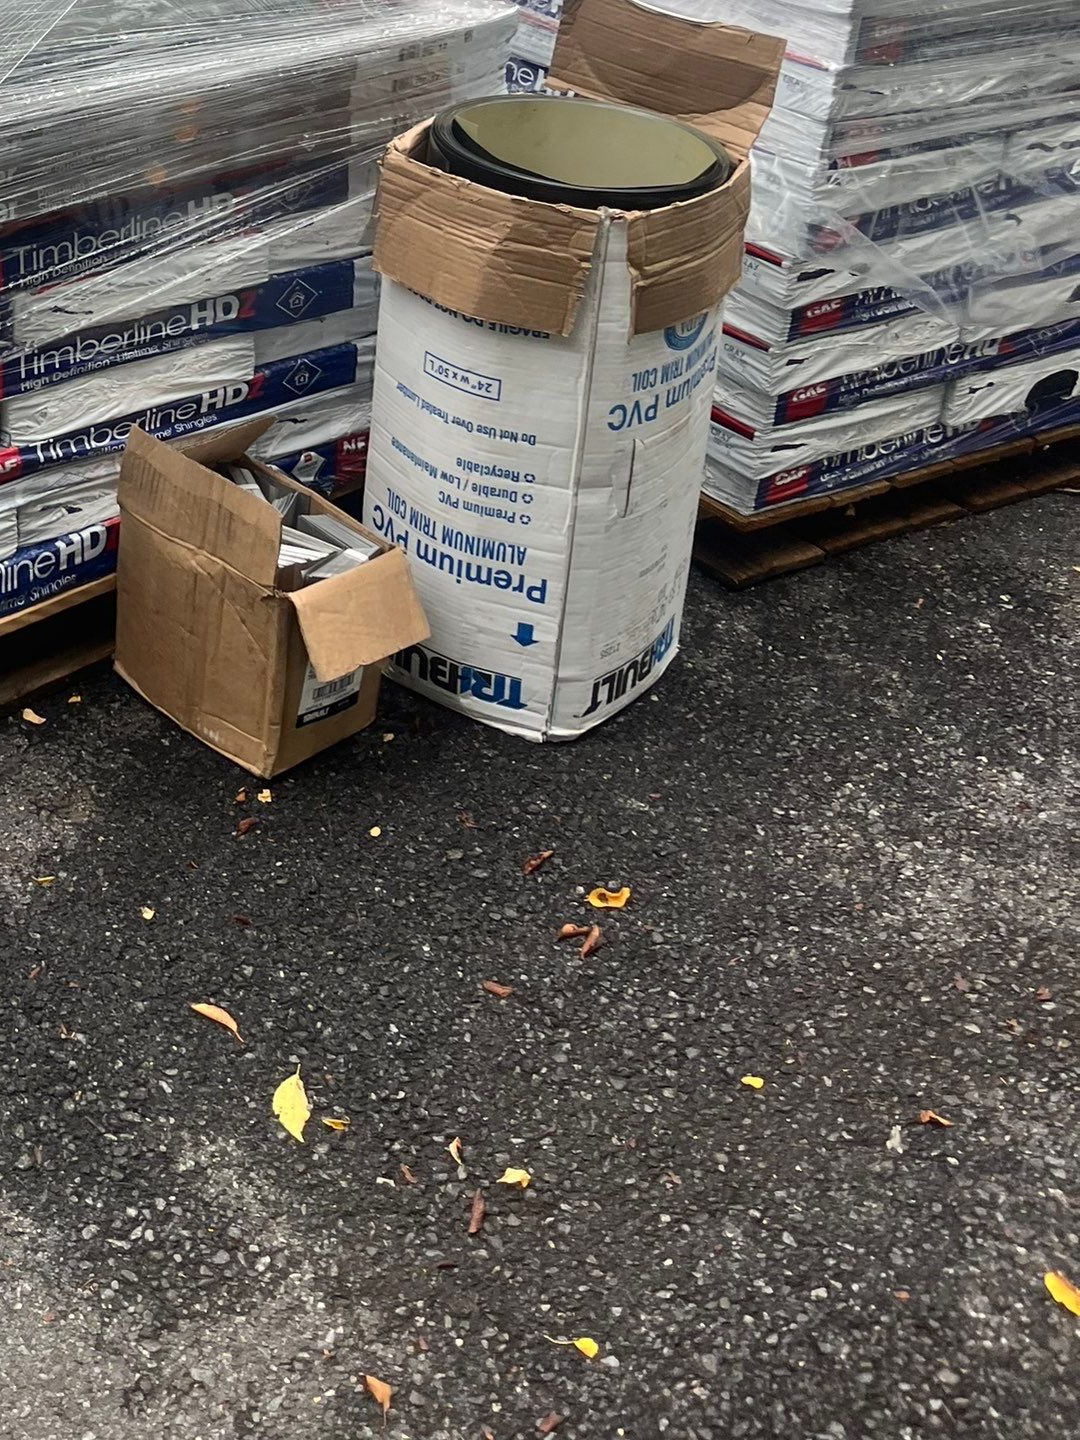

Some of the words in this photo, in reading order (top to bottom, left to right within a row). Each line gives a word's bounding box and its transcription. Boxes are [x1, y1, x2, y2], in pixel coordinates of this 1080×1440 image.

[21, 376, 50, 391] High
[53, 357, 110, 383] Definition
[452, 371, 458, 380] x
[632, 368, 657, 392] COIL
[661, 358, 683, 384] TRIM
[396, 381, 420, 407] Lumber
[174, 414, 217, 431] Shingles
[419, 399, 449, 425] Treated
[451, 416, 474, 433] Over
[607, 394, 659, 431] PVC
[476, 424, 497, 438] Use
[499, 430, 518, 443] Not
[521, 434, 536, 446] Do
[391, 436, 437, 479] Maintenance
[456, 457, 520, 482] Recyclable
[440, 472, 460, 489] Low
[471, 482, 518, 503] Durable
[387, 487, 407, 519] COIL
[438, 490, 459, 508] PVC
[409, 507, 437, 540] TRIM
[462, 501, 516, 523] Premium
[373, 504, 409, 555] PVC
[442, 525, 527, 566] ALUMINUM
[416, 539, 547, 604] Premium
[29, 573, 77, 601] Shingles
